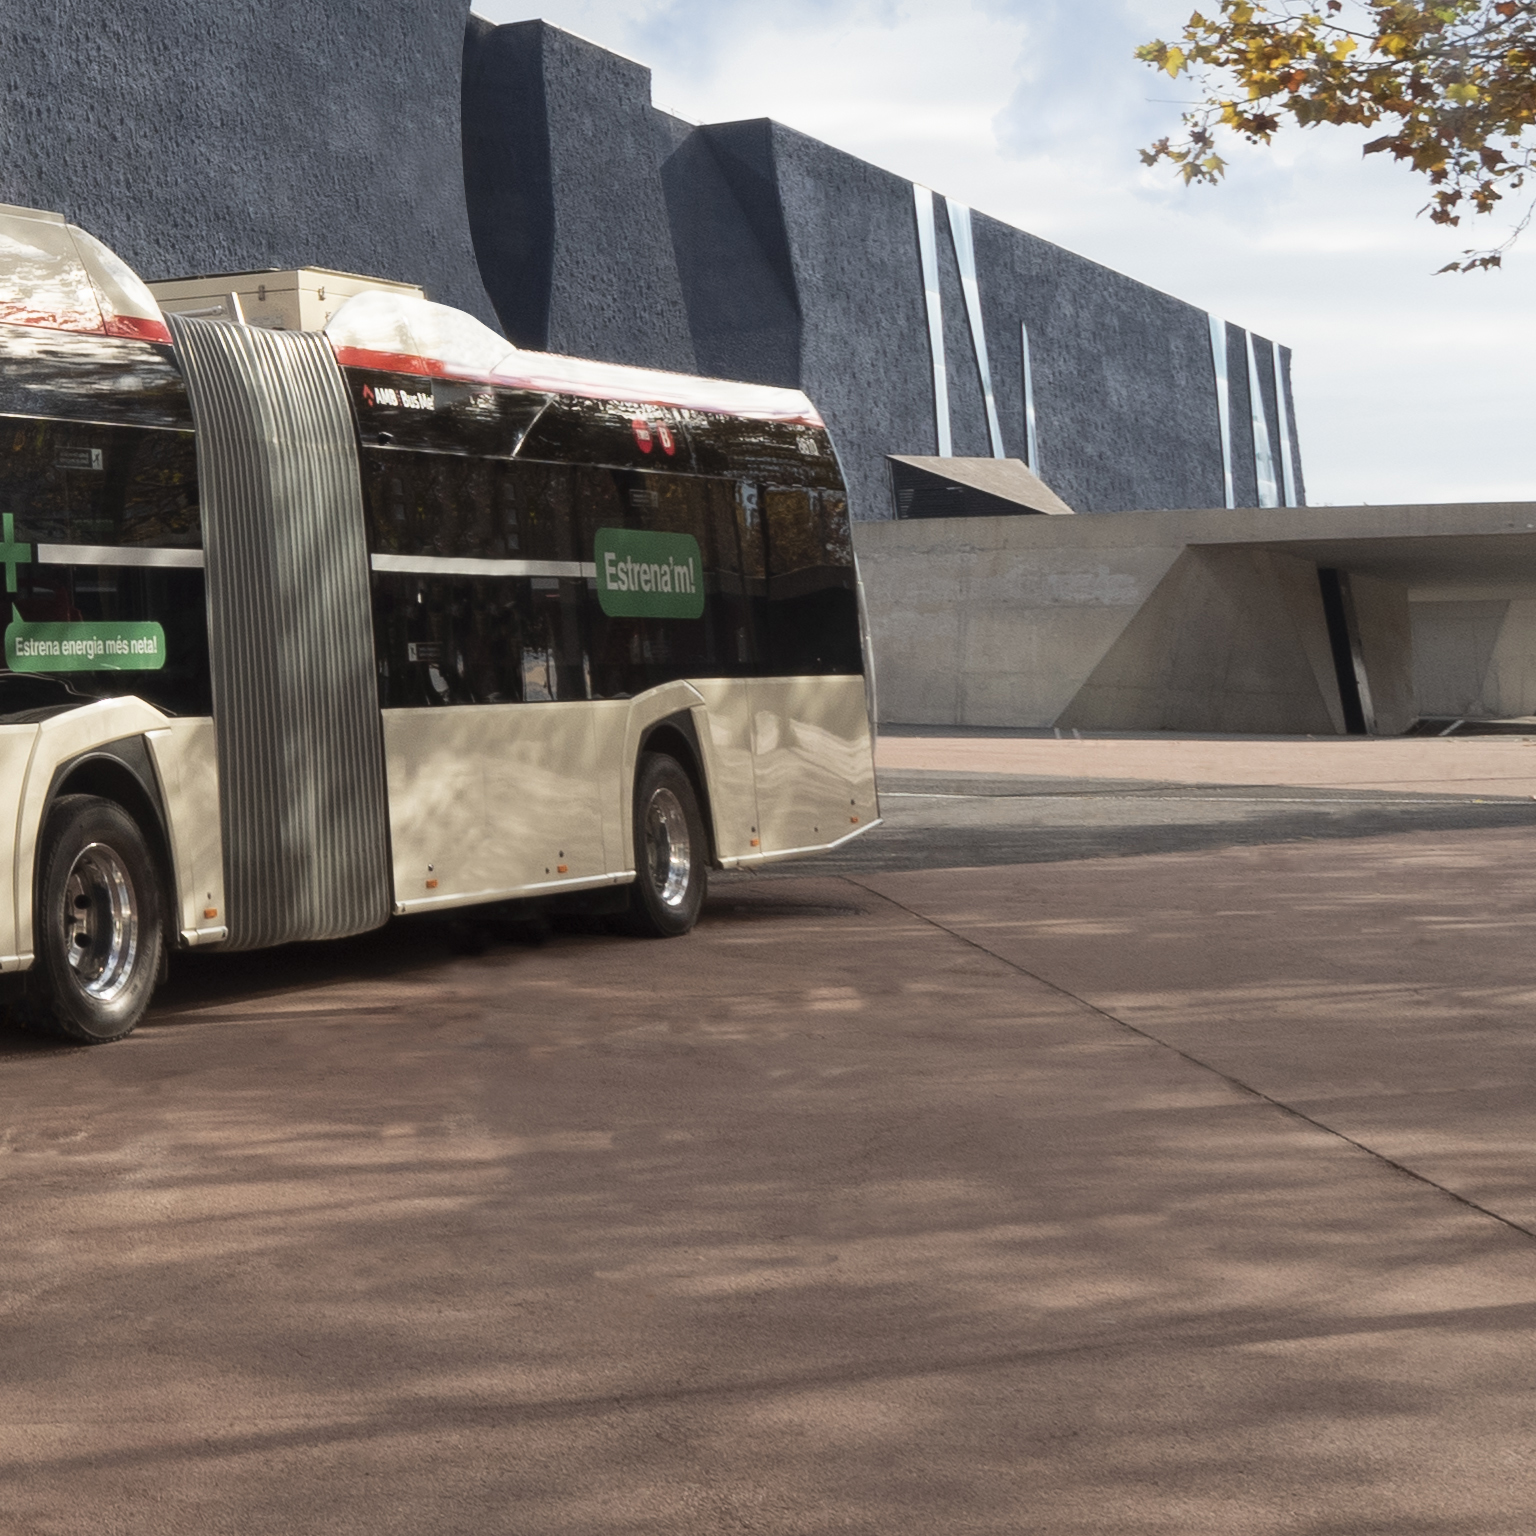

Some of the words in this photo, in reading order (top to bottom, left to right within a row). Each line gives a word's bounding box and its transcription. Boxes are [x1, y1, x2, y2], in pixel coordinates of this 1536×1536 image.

[604, 551, 696, 594] Estrena'm!
[15, 636, 61, 656] Estrena
[61, 635, 105, 660] energia
[105, 634, 129, 655] més
[130, 635, 158, 655] neta!
